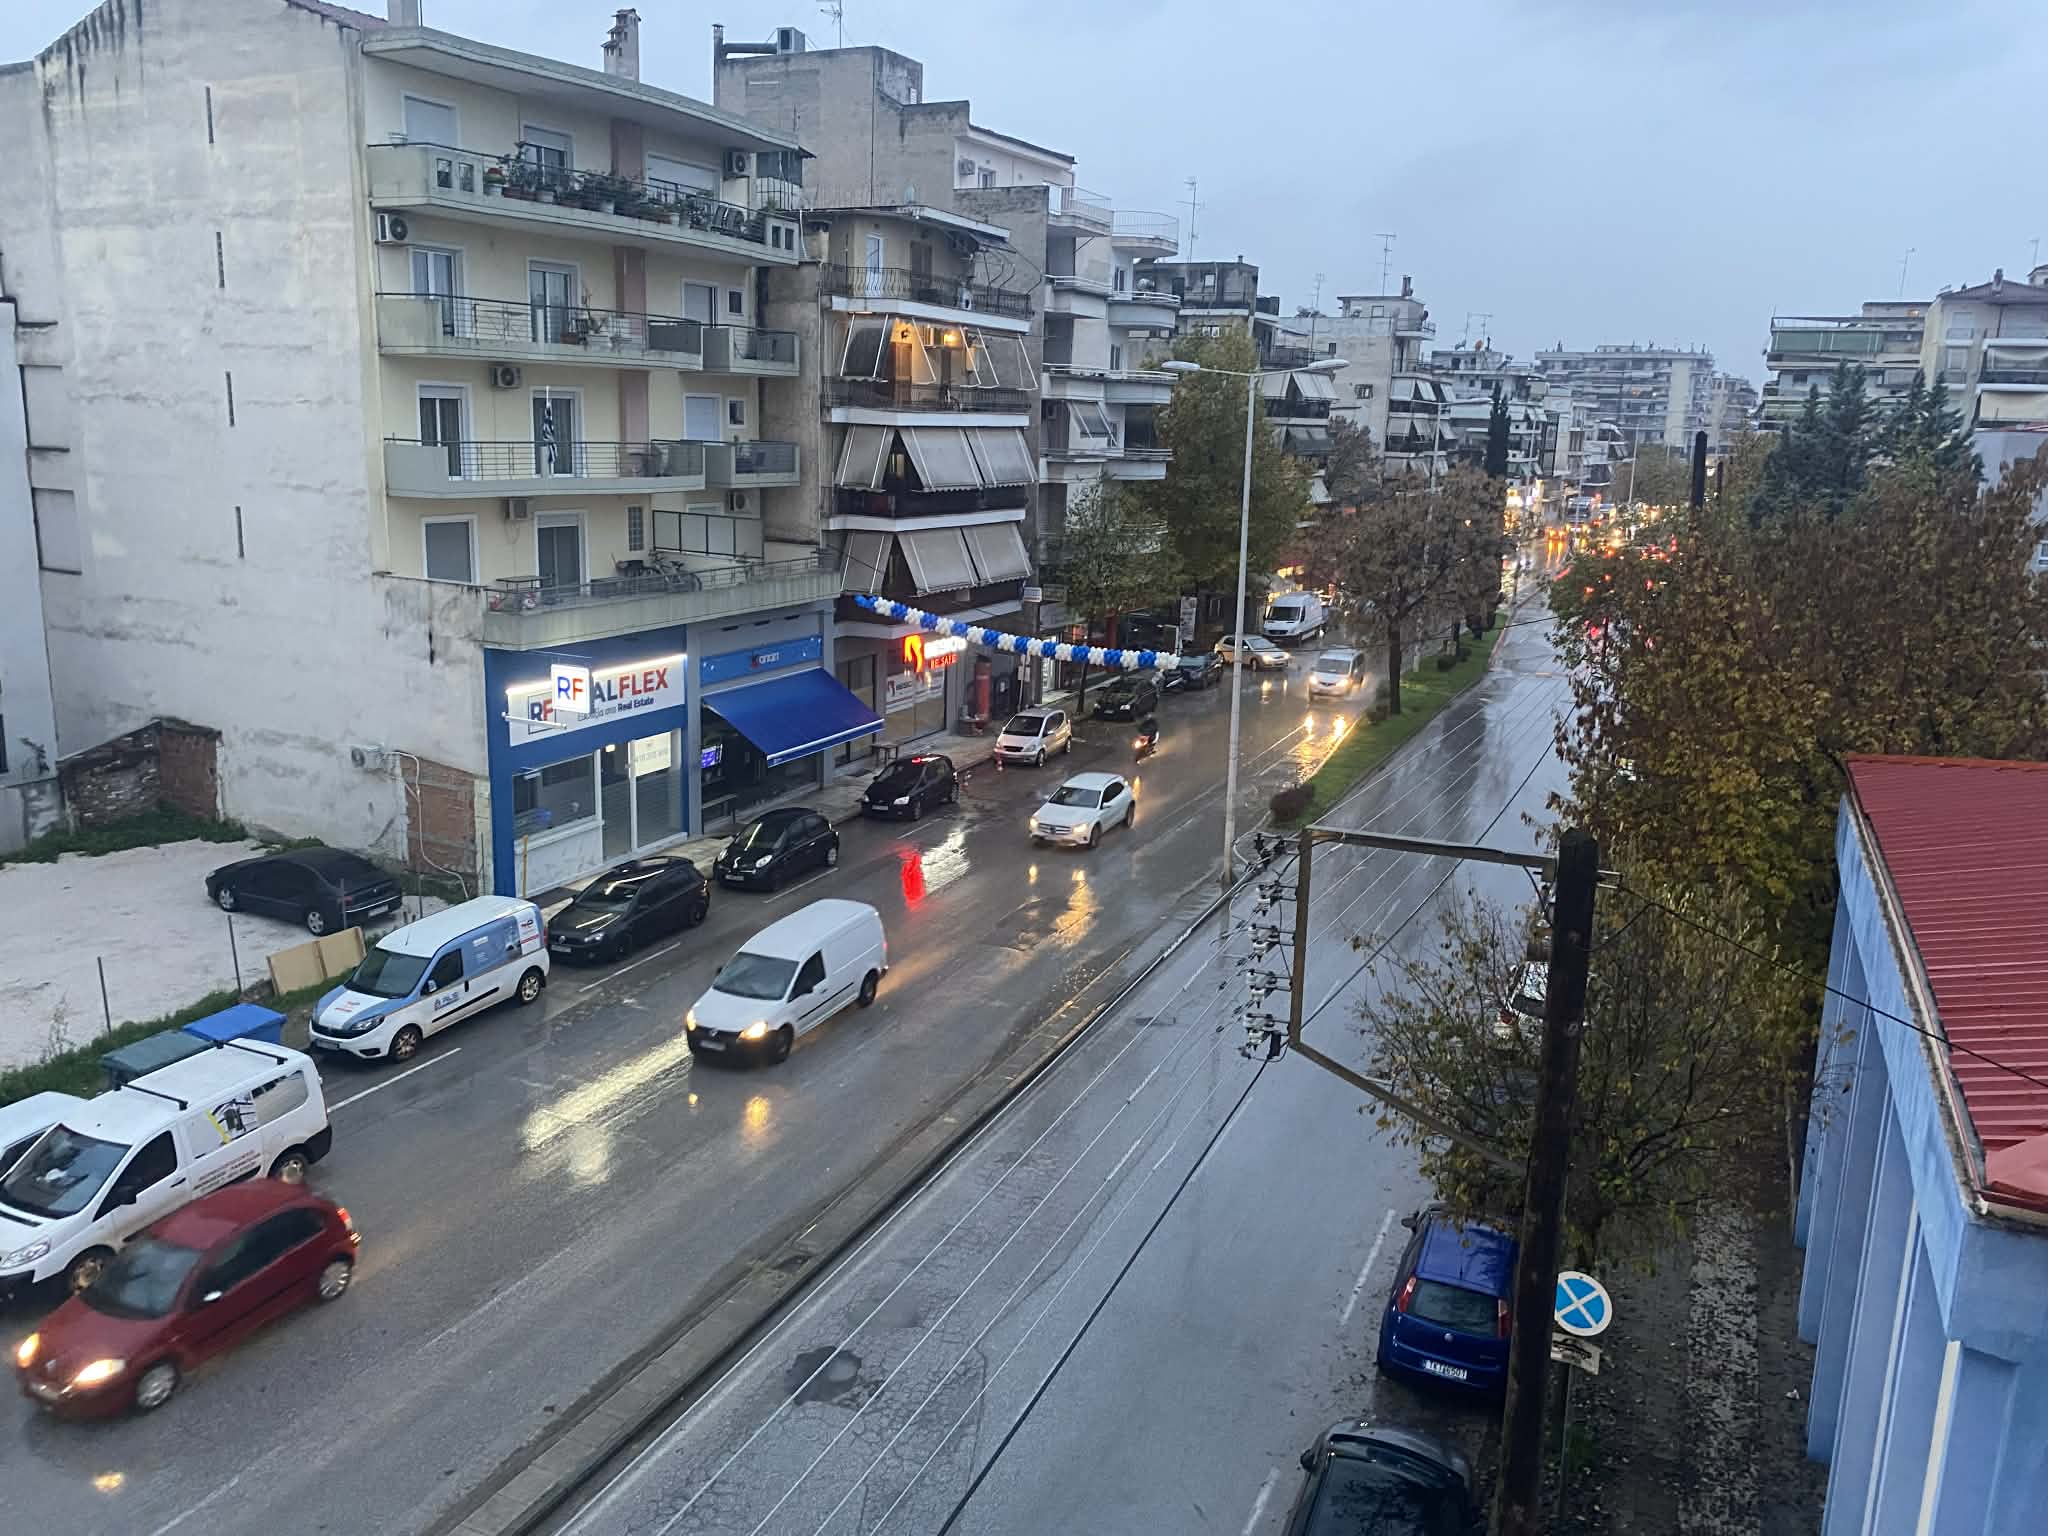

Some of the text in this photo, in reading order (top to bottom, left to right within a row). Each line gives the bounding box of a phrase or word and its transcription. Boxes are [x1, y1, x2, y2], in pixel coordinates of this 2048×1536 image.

[557, 675, 584, 700] RF
[530, 698, 554, 722] RF
[617, 696, 655, 713] Real Estate
